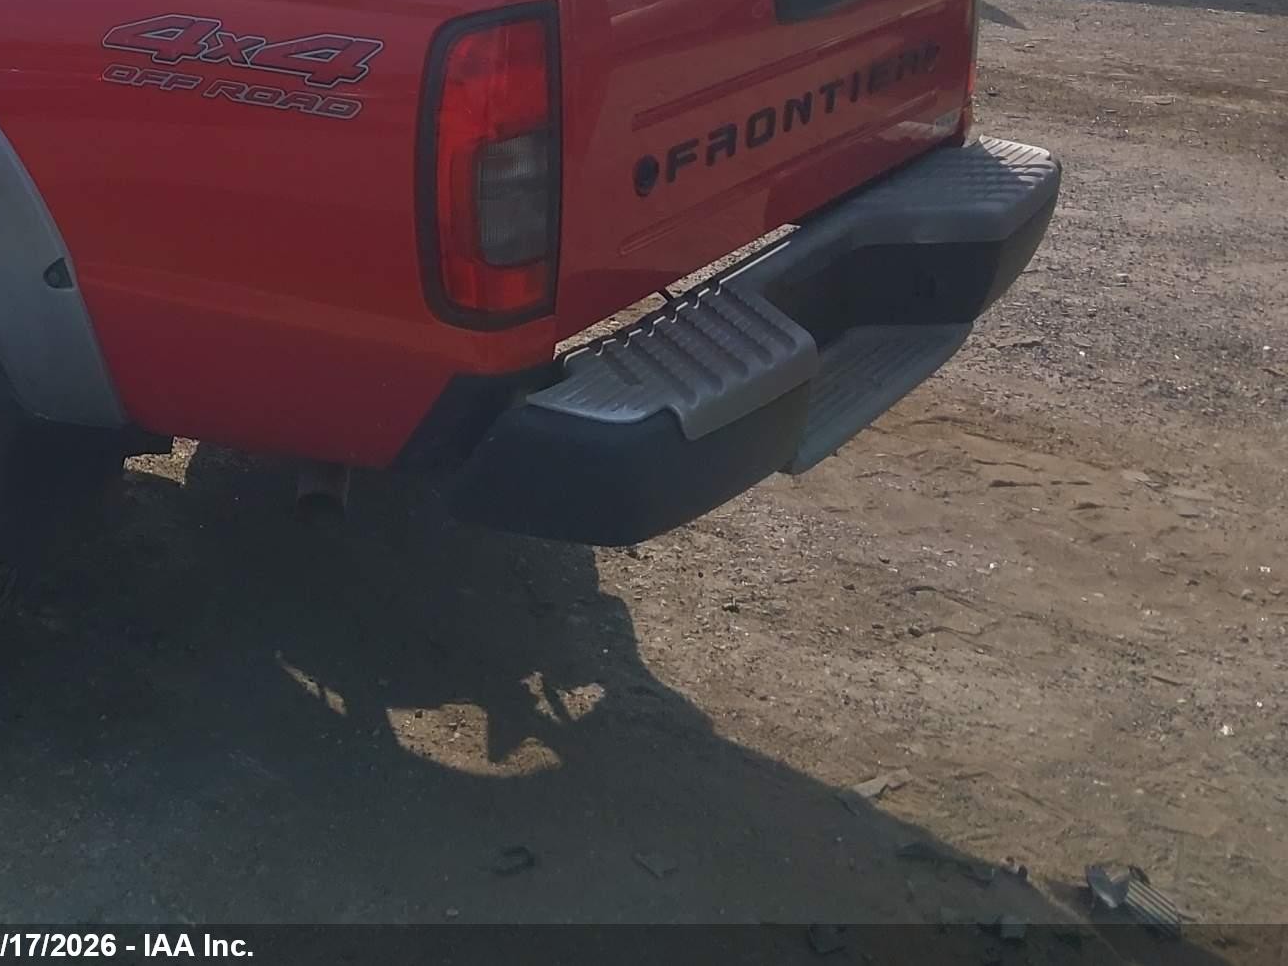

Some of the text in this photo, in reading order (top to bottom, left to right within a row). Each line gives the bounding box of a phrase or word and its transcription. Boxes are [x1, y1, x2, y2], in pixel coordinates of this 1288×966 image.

[102, 64, 363, 119] OFF ROAD
[666, 41, 940, 183] FRONTIER
